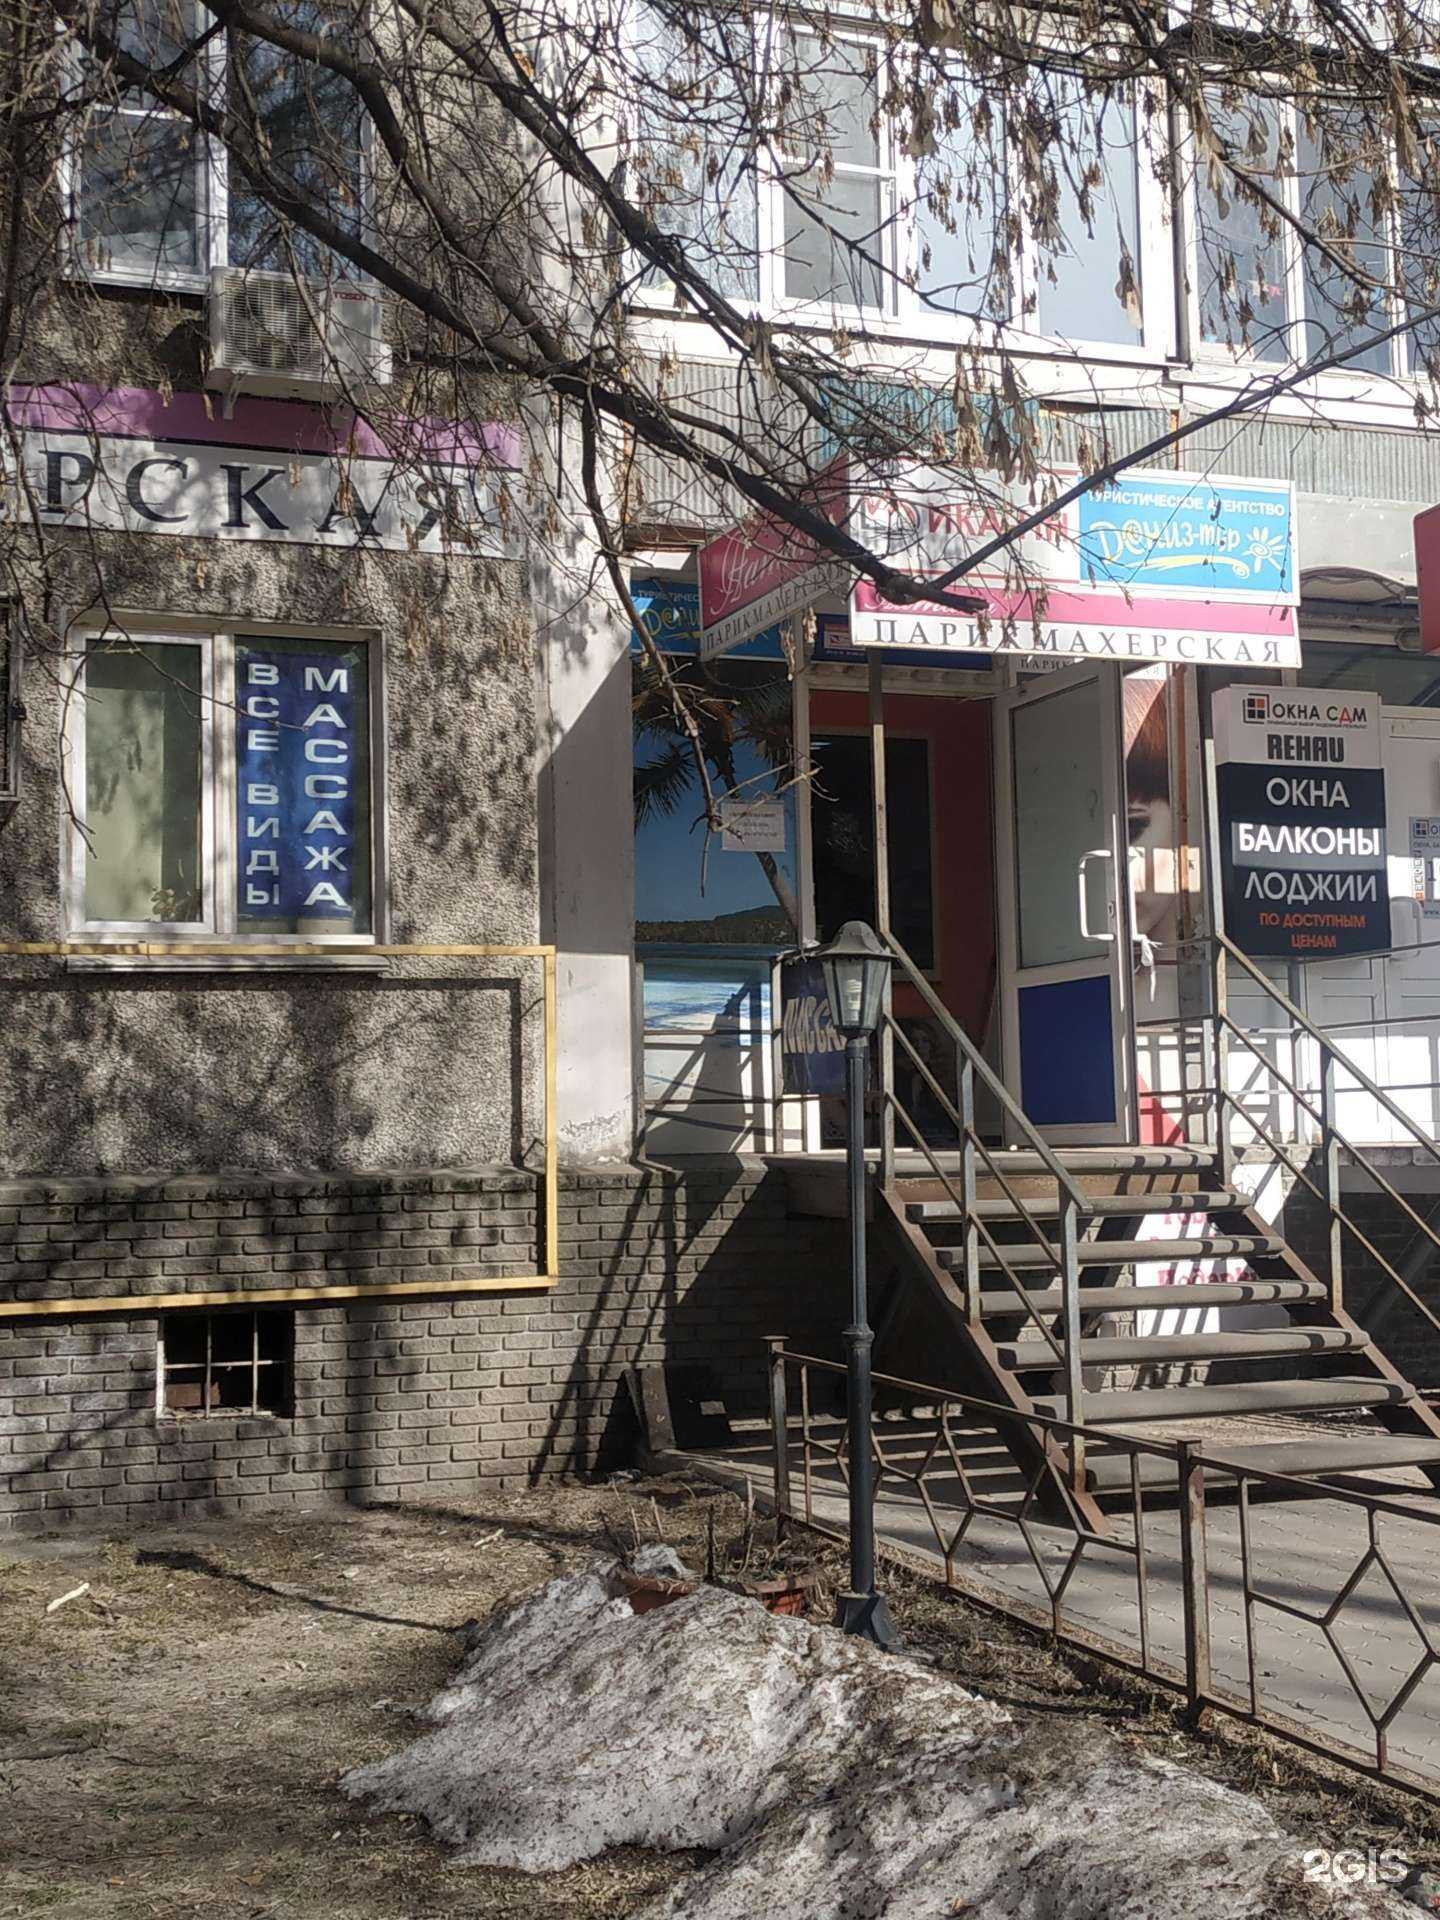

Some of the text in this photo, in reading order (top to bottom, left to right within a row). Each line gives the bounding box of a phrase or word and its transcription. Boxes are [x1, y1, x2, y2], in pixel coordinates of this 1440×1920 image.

[0, 450, 467, 544] РСКАЯ
[1088, 490, 1204, 511] ТУРИСТИЧЕСКОЕ
[873, 618, 1280, 662] ПАРИКМАХЕРСКАЯ
[1272, 703, 1320, 721] ОКНА
[1267, 734, 1344, 763] REHAU
[246, 663, 280, 905] ВСЕ ВИДЫ
[303, 667, 349, 907] МАССАЖА
[1266, 777, 1350, 809] ОКНА
[1239, 823, 1380, 857] БАЛКОНЫ
[1244, 872, 1377, 905] ЛОДЖИИ
[1259, 912, 1367, 929] ПО ДОСТУПНЫМ
[1290, 934, 1337, 949] ЦЕНАМ
